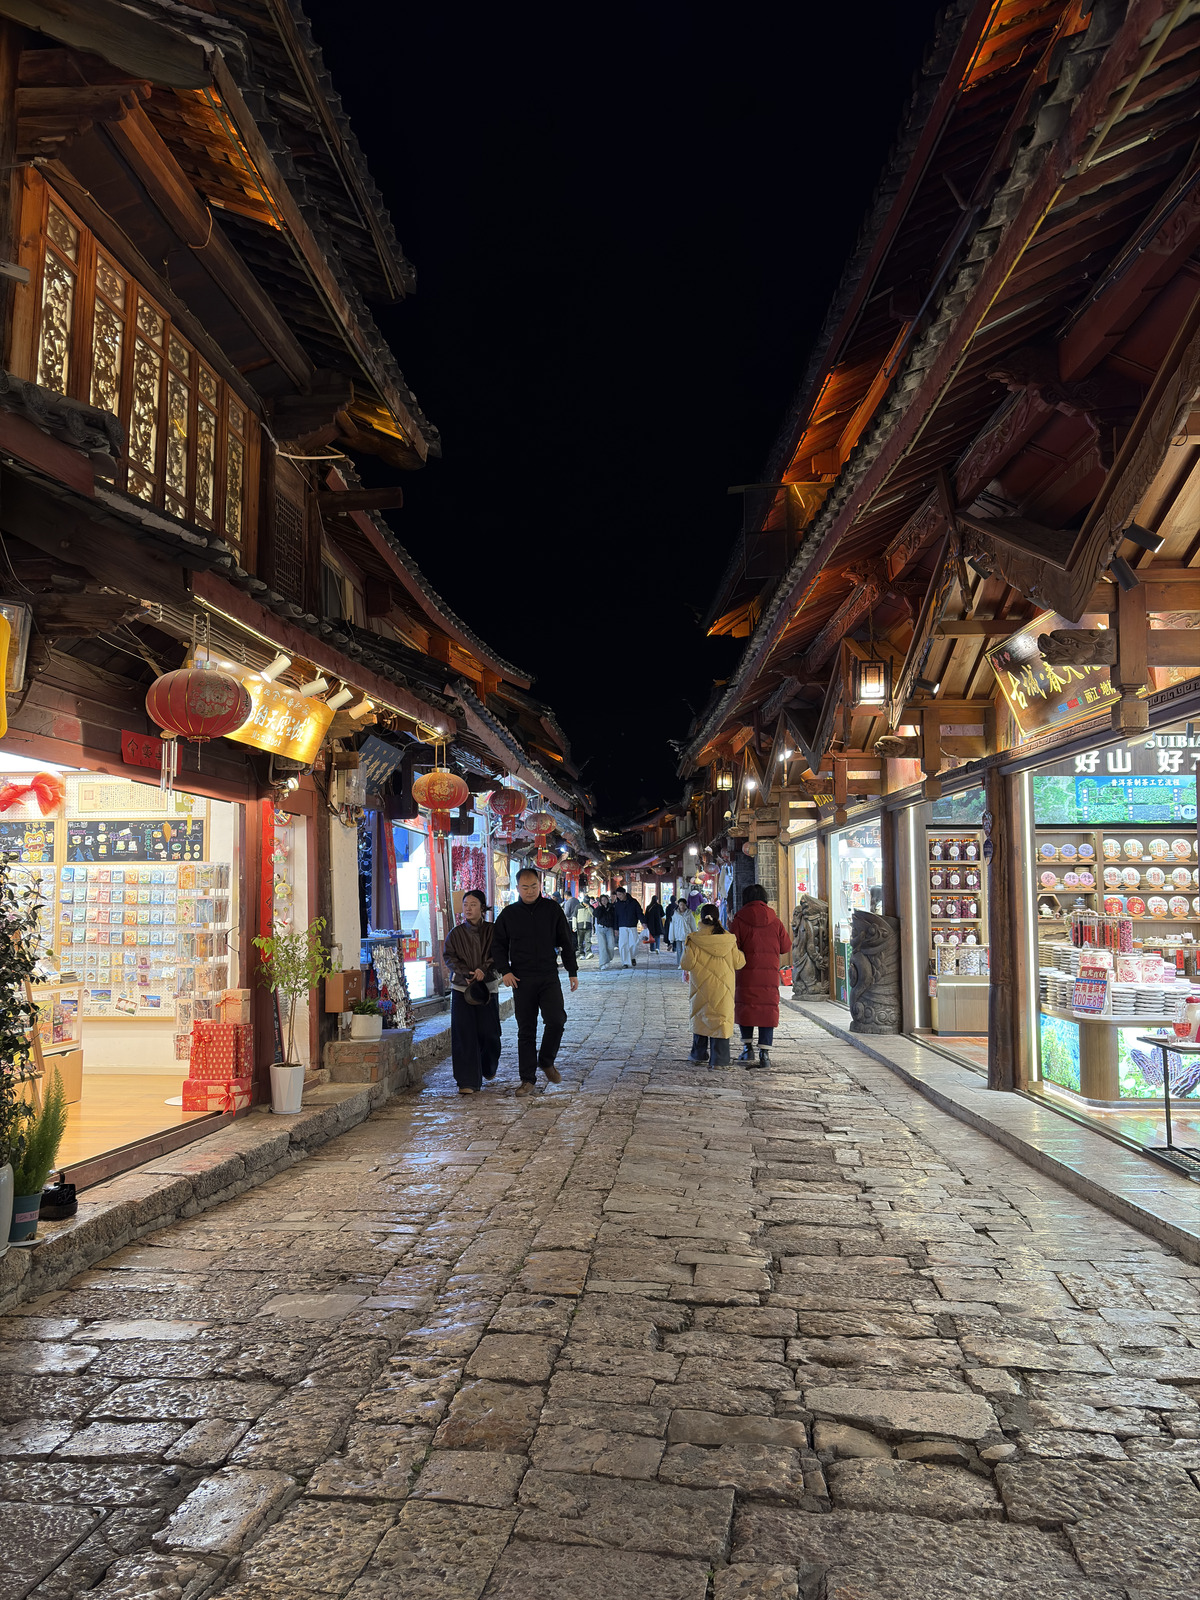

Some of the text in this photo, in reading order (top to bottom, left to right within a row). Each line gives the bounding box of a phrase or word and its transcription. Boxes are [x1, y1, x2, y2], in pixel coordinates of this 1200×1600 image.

[1111, 778, 1181, 787] 普洱茶制茶工艺流程
